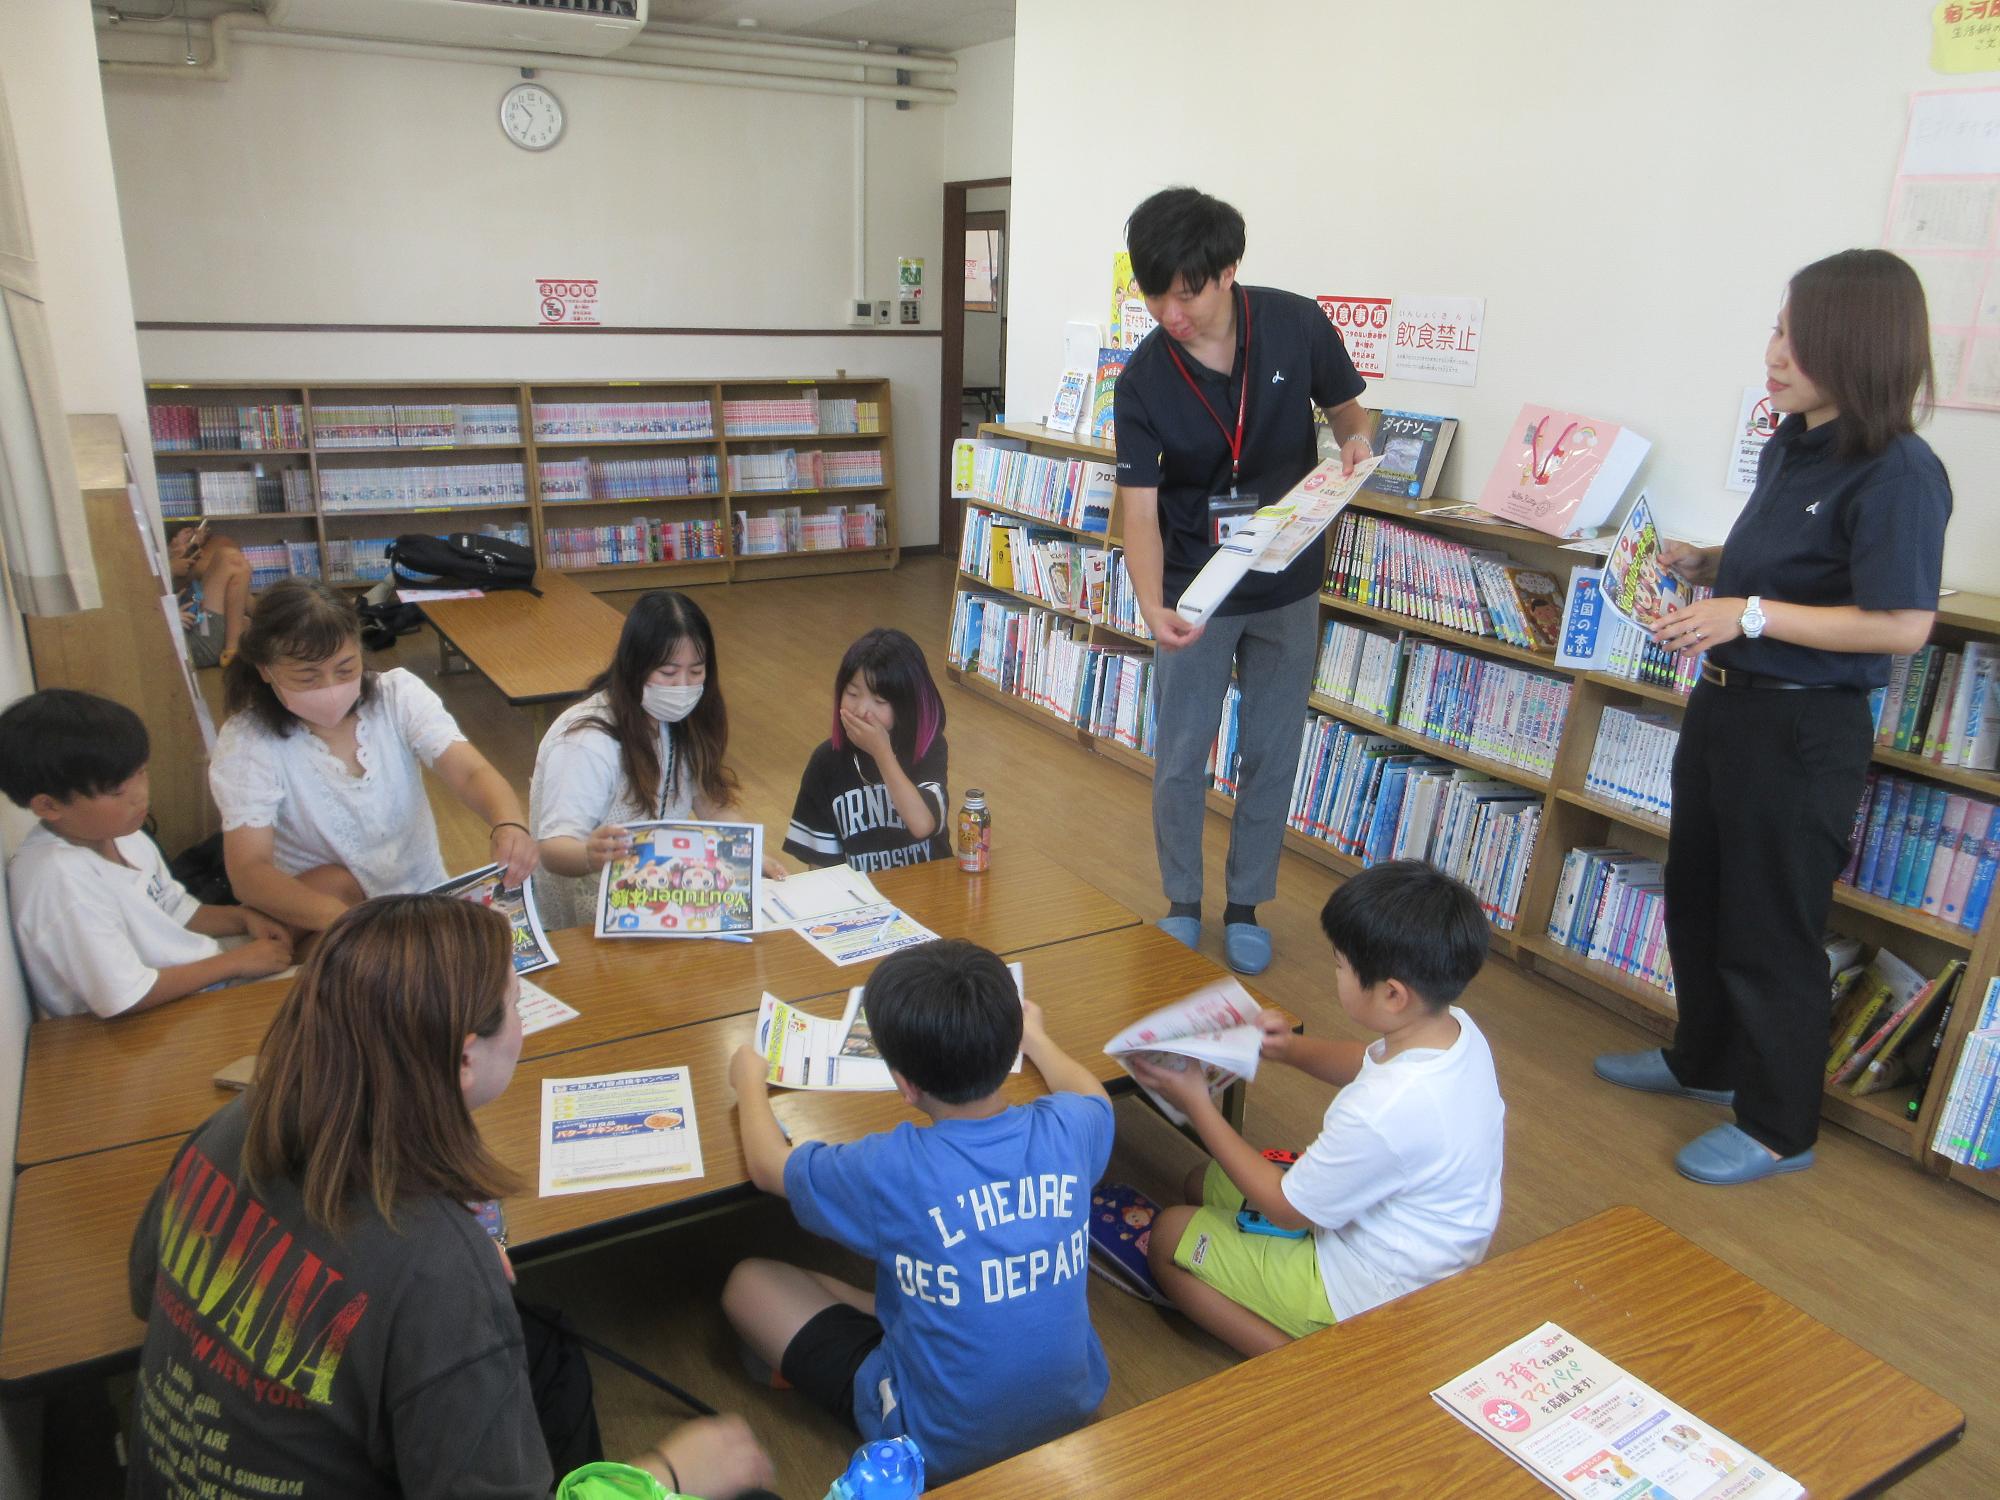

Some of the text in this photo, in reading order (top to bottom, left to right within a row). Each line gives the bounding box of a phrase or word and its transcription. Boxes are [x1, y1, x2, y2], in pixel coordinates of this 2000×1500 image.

[1395, 321, 1477, 352] 飲食禁止
[1382, 417, 1433, 434] ダイナソー
[1574, 587, 1597, 647] 外国の本
[610, 888, 746, 908] YouTuber体験
[928, 1174, 1078, 1248] L'HEURE
[896, 1254, 961, 1307] DES
[203, 1429, 230, 1452] ARE
[233, 1468, 305, 1497] SUNBEAM
